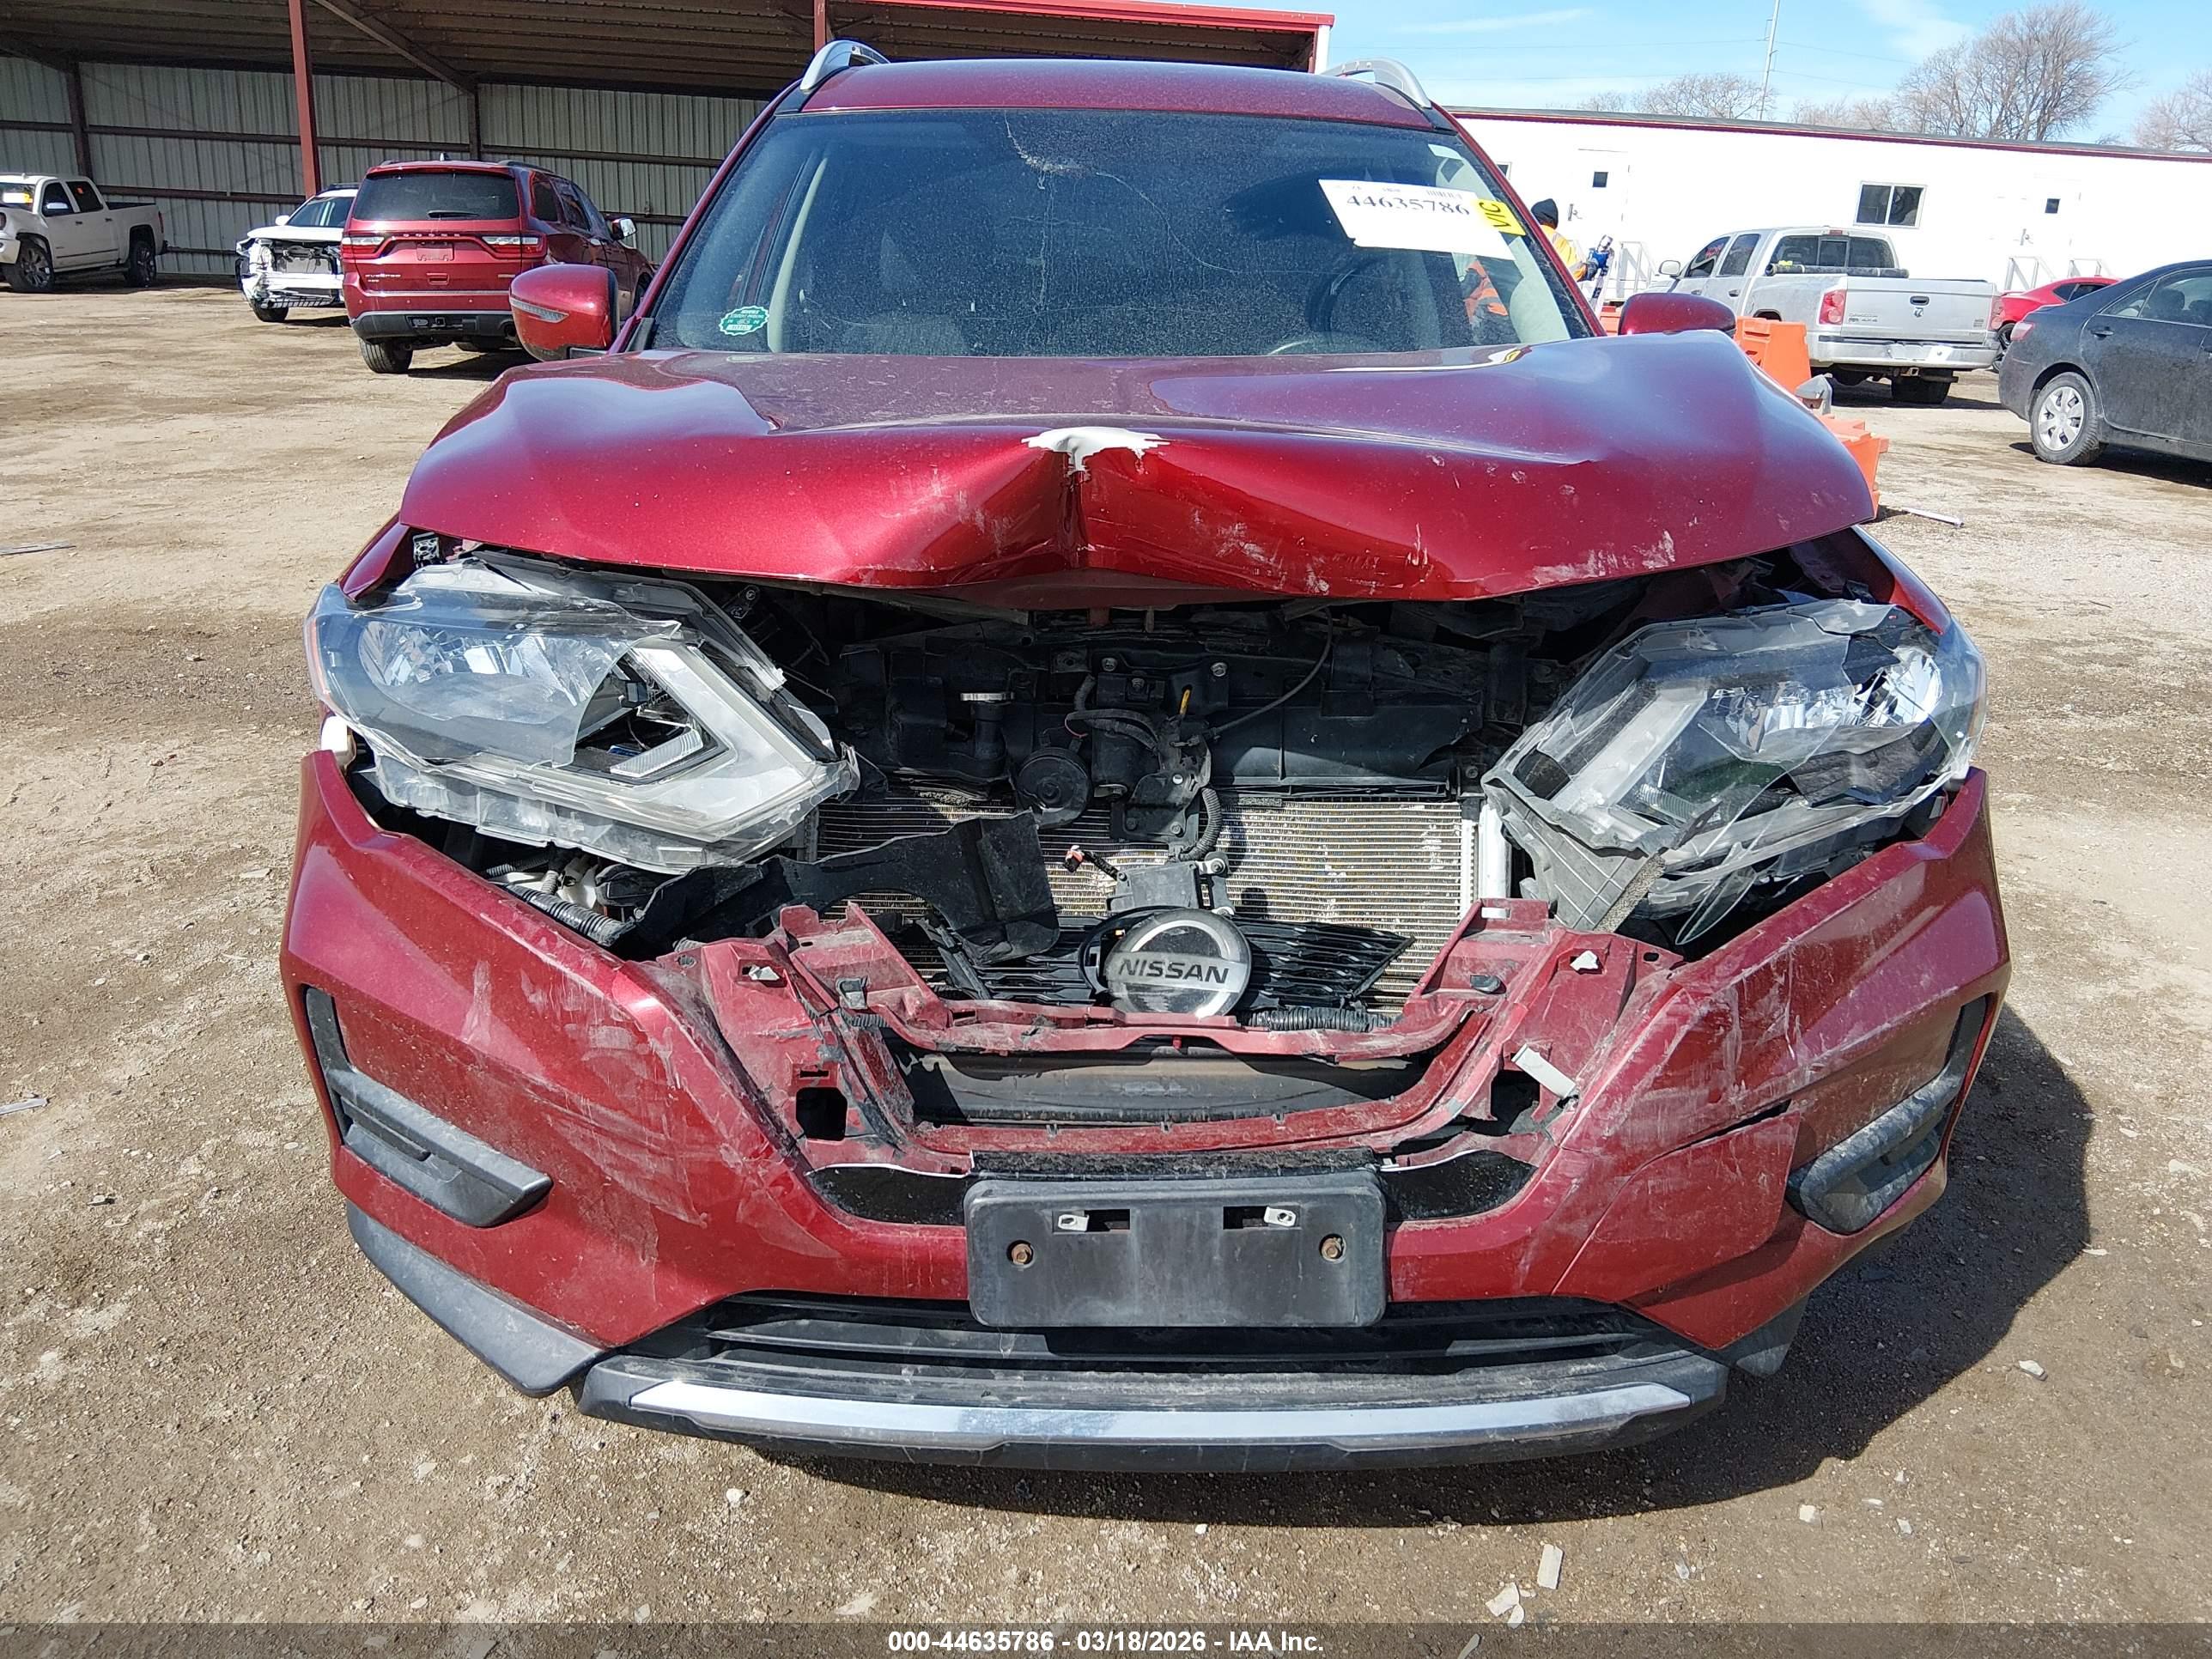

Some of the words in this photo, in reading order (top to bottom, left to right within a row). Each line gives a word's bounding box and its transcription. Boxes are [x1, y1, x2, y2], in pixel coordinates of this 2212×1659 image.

[1346, 194, 1470, 216] 44635786
[1478, 202, 1511, 228] VIC
[1119, 957, 1230, 984] NISSAN
